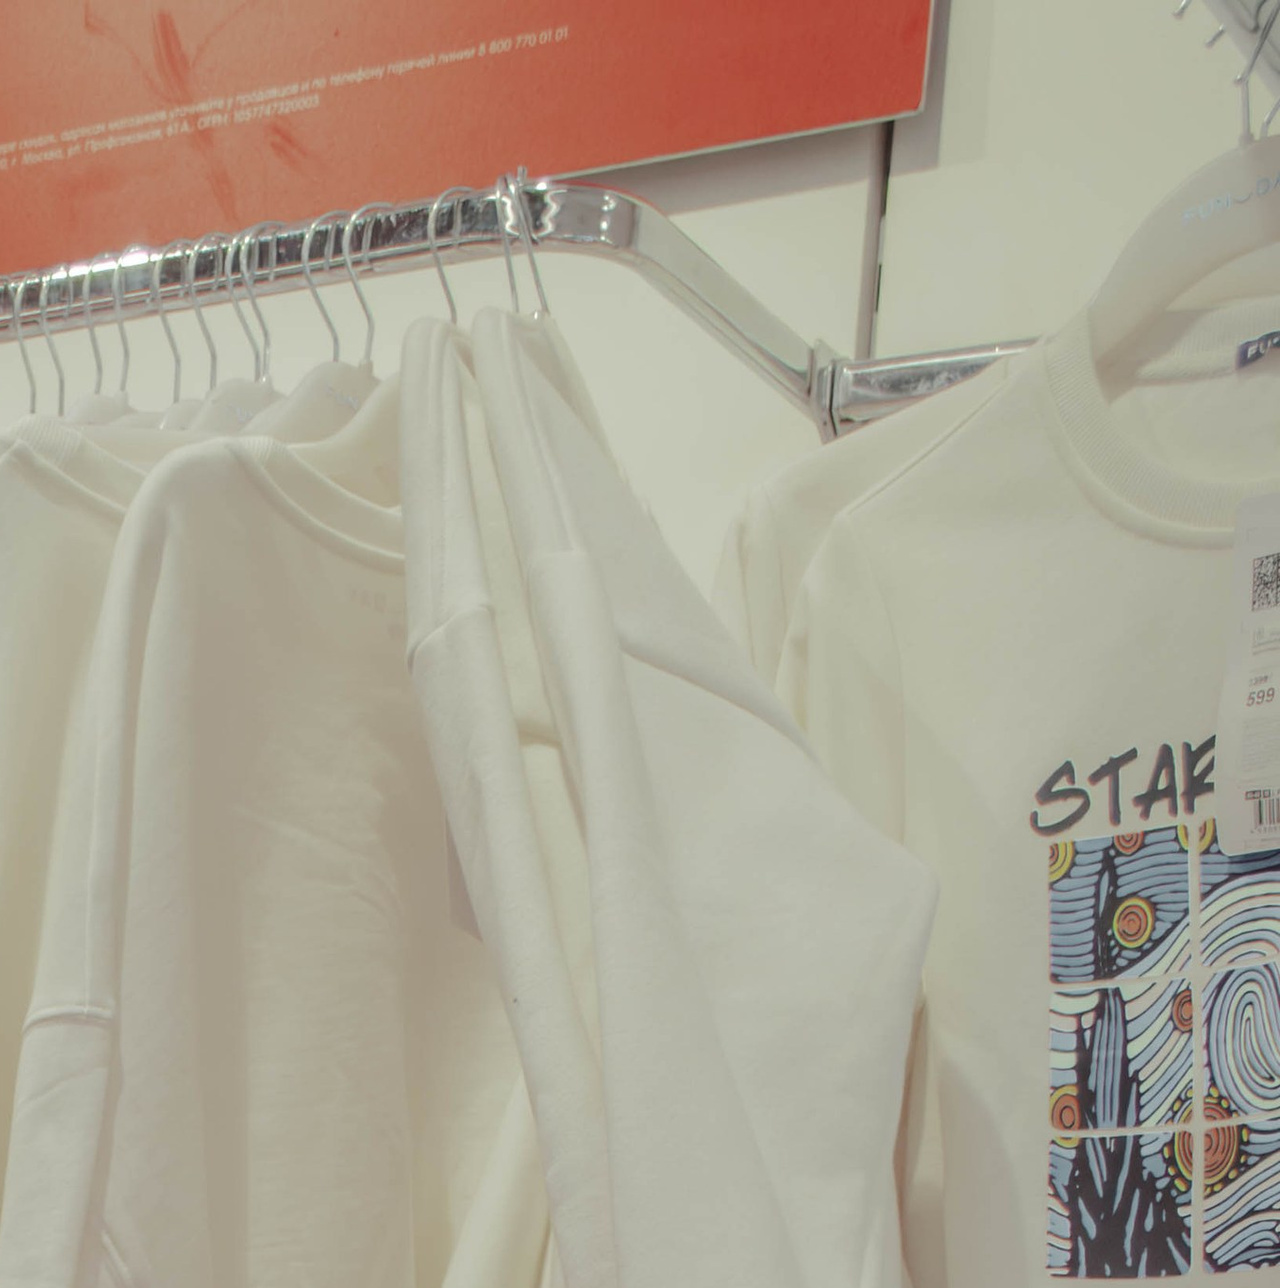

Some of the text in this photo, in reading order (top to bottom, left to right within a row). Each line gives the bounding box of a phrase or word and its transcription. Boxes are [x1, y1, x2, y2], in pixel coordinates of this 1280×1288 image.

[488, 37, 512, 53] 800
[515, 31, 537, 47] 770
[1245, 687, 1275, 707] 599
